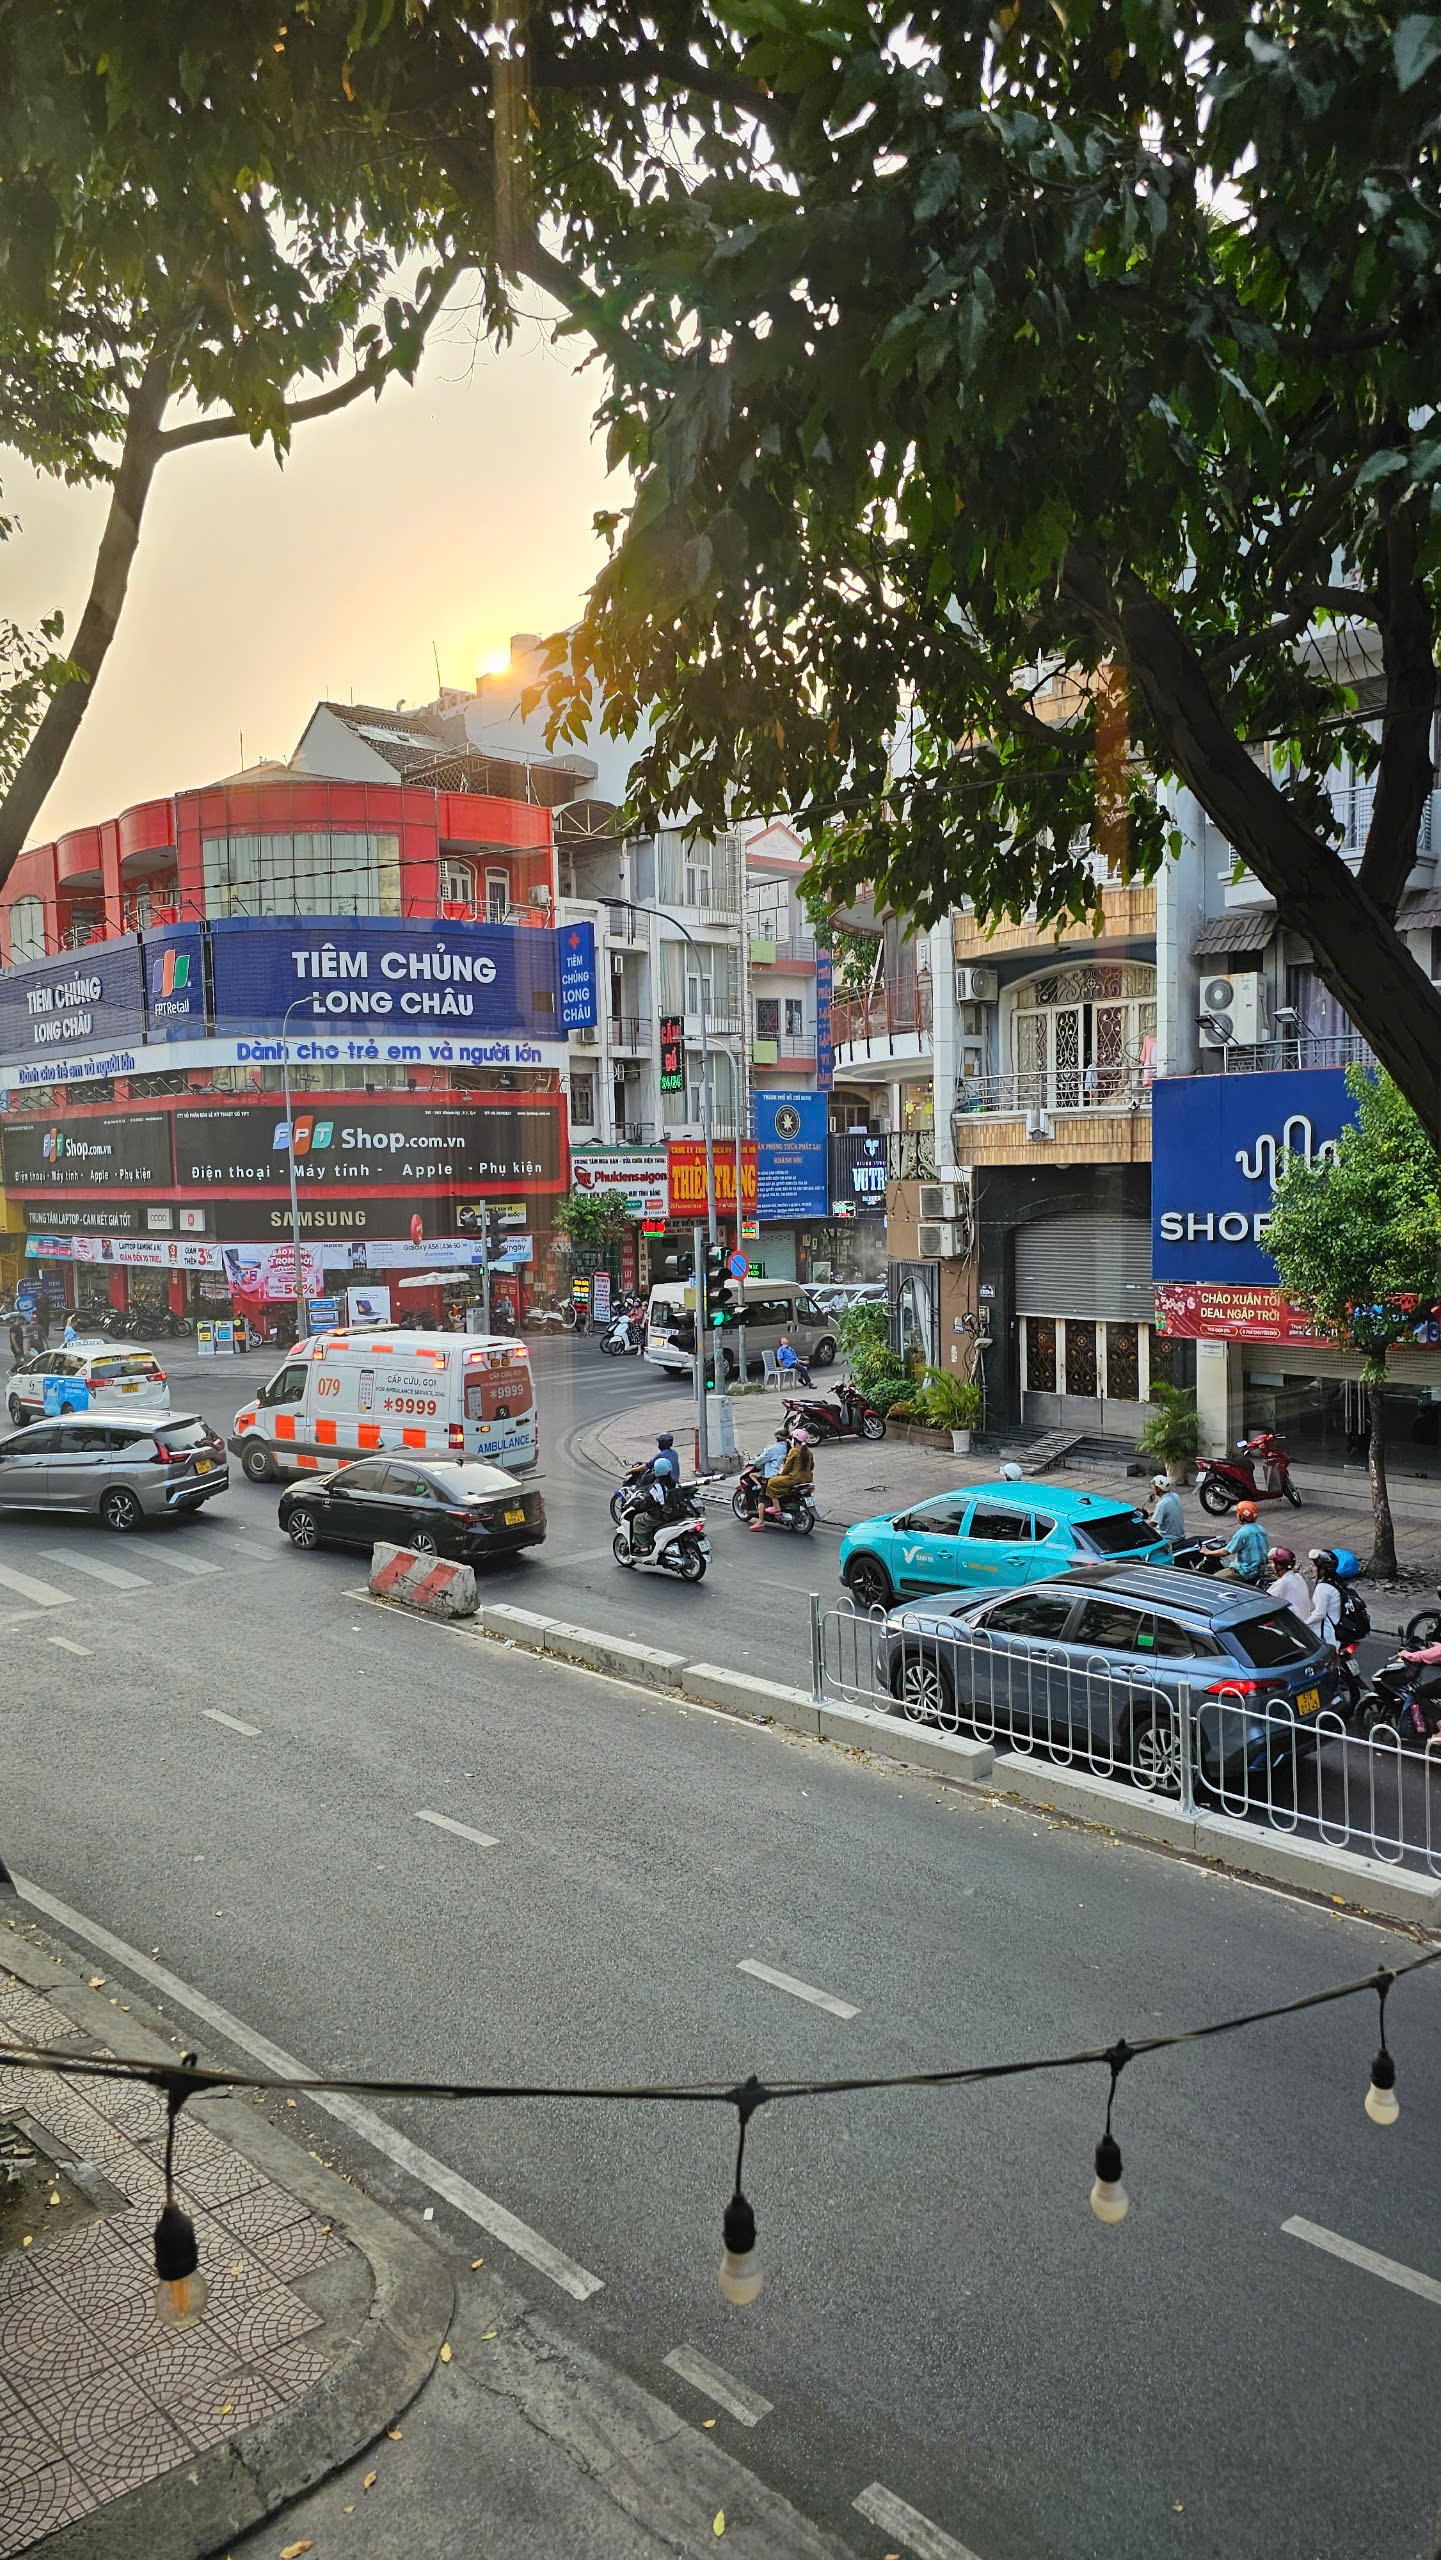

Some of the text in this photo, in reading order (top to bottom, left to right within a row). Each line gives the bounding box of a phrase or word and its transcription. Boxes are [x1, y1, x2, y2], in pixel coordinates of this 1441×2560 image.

[291, 942, 497, 984] TIÊM CHỦNG
[566, 955, 583, 968] TIÊM
[562, 969, 589, 985] CHỦNG
[26, 970, 102, 1015] TIÊM CHỦNG
[312, 987, 474, 1016] LONG CHÂU
[563, 988, 590, 1004] LONG
[563, 1004, 591, 1022] CHÂU
[34, 1010, 92, 1043] LONG CHÂU
[236, 1038, 542, 1066] Dành cho trẻ em và người lớn
[69, 1066, 83, 1078] em
[65, 1138, 112, 1160] Shop.com.vn
[341, 1127, 466, 1154] Shop.com.vn
[90, 1169, 109, 1183] Apple
[191, 1160, 543, 1182] Điện thoại Máy tính Apple Phụ kiện
[29, 1212, 47, 1224] TRUNG
[58, 1213, 80, 1226] LAPTOP
[270, 1209, 367, 1228] SAMSUNG
[1201, 1290, 1231, 1304] CHÀO
[1233, 1292, 1261, 1306] XUÂN
[1200, 1306, 1280, 1322] DEAL NGẬP TRỜI
[317, 1377, 340, 1397] 079
[387, 1375, 402, 1385] CẤP
[386, 1386, 414, 1395] AMBULANCE
[477, 1433, 530, 1455] AMBULANCE
